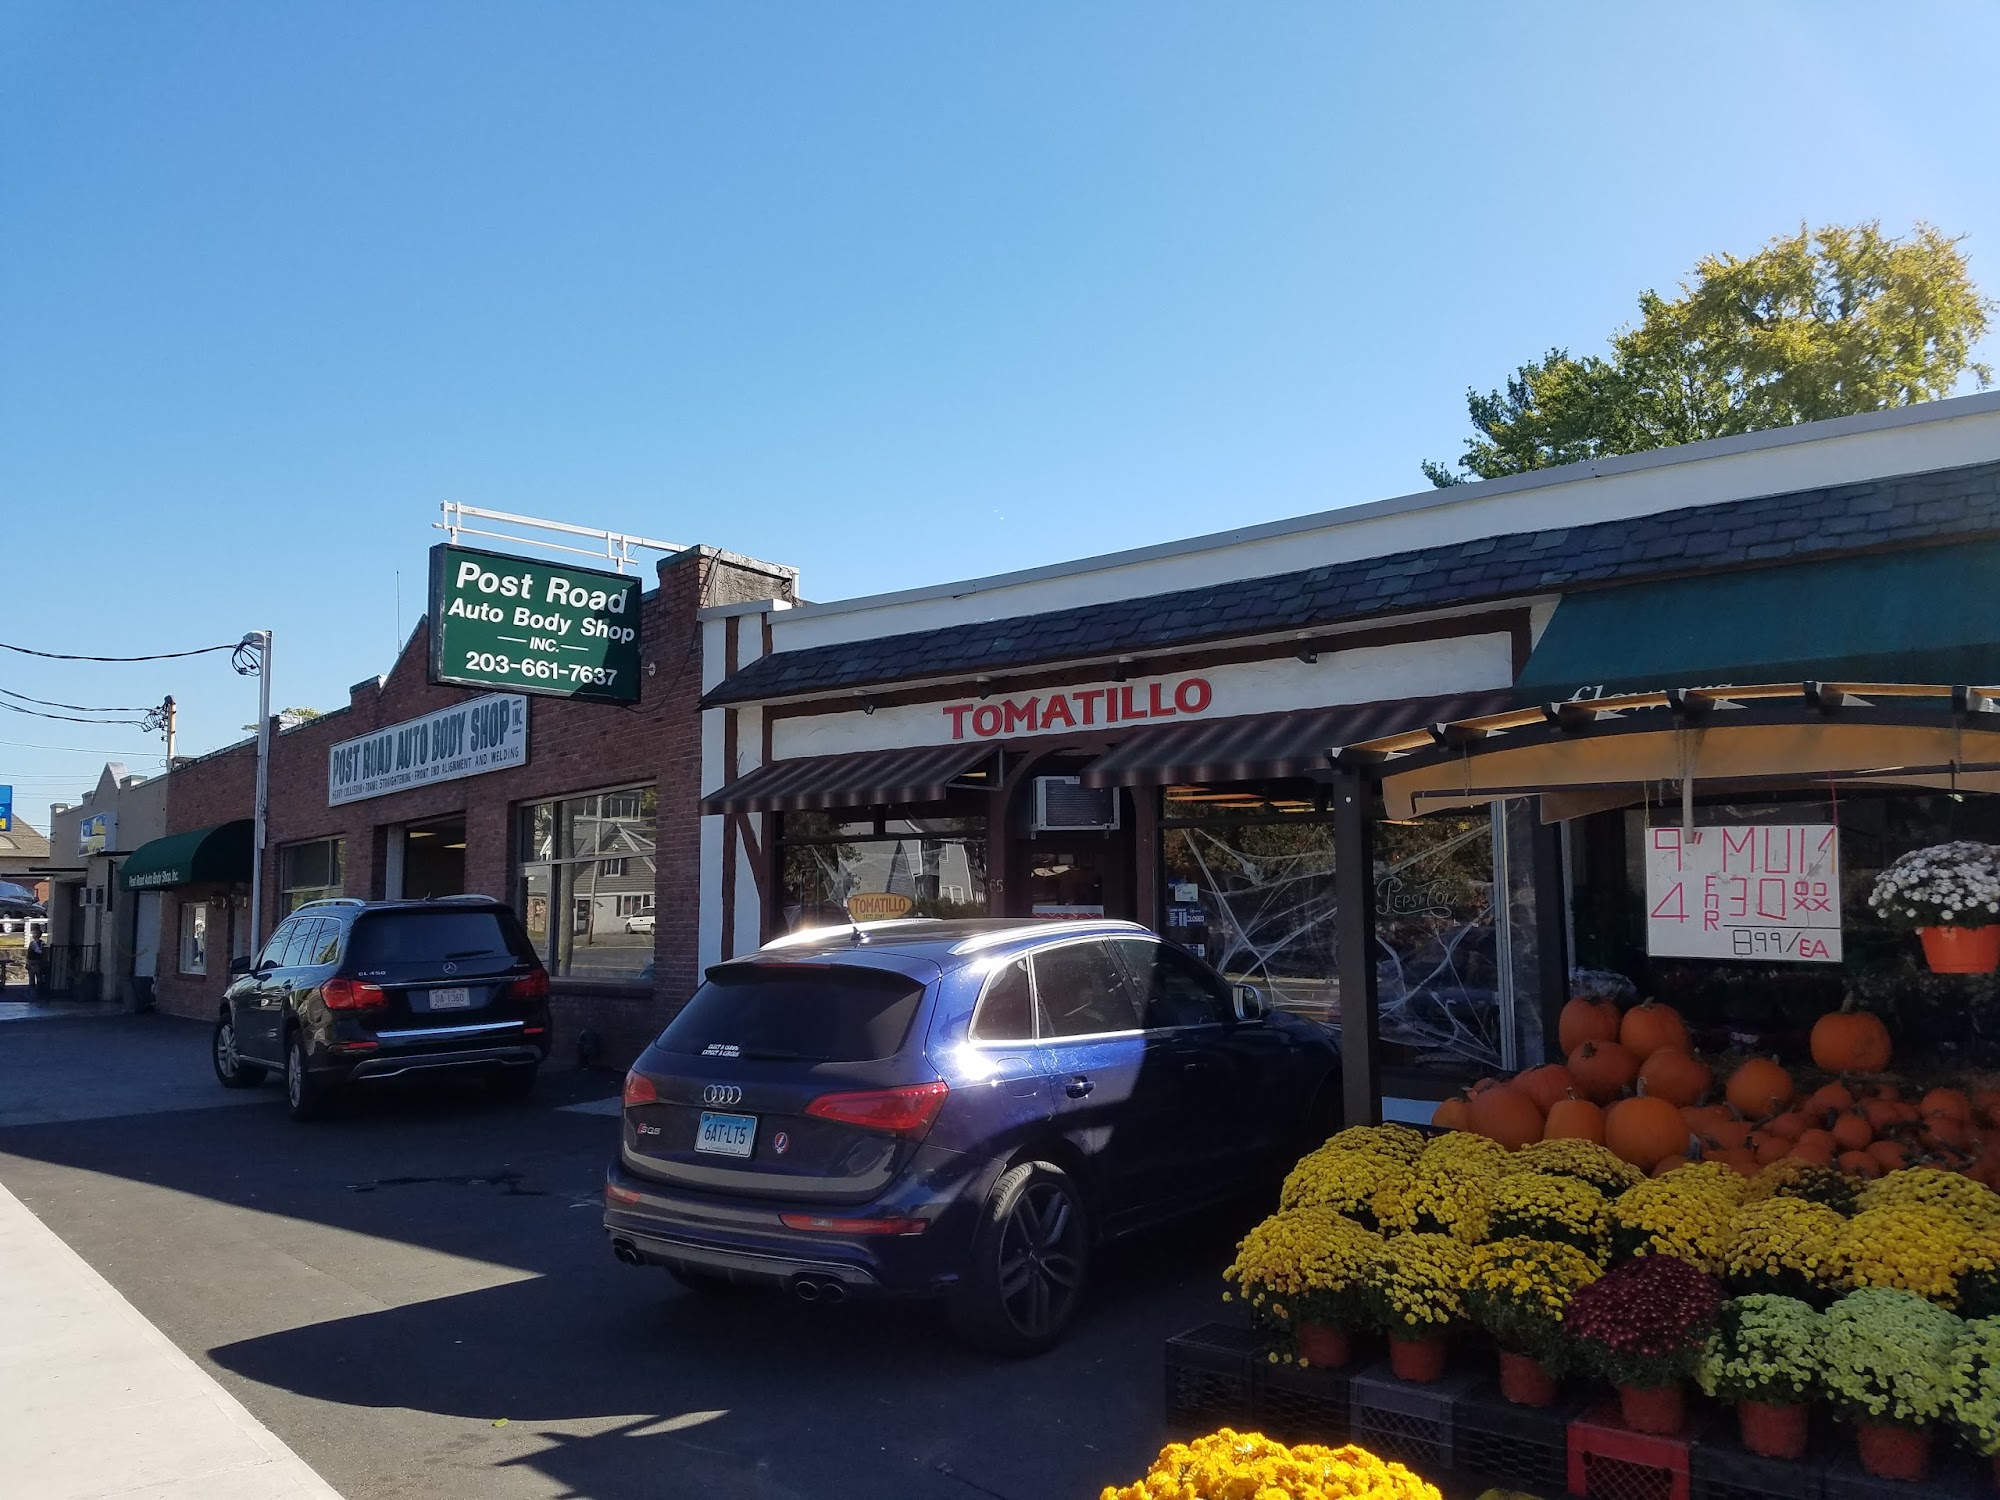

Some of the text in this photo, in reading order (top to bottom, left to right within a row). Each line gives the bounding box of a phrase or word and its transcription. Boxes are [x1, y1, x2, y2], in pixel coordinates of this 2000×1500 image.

[455, 561, 628, 614] Post Road
[447, 597, 635, 644] Auto Body Shop
[529, 636, 560, 653] INC.
[465, 651, 618, 686] 203-661-7637
[942, 677, 1213, 740] TOMATILLO
[332, 699, 511, 788] POST ROAD AUTO BODY SHOP
[474, 754, 488, 767] AND
[491, 746, 519, 764] WELDING
[853, 897, 906, 914] TOMATILLO
[1650, 881, 1690, 924] 4
